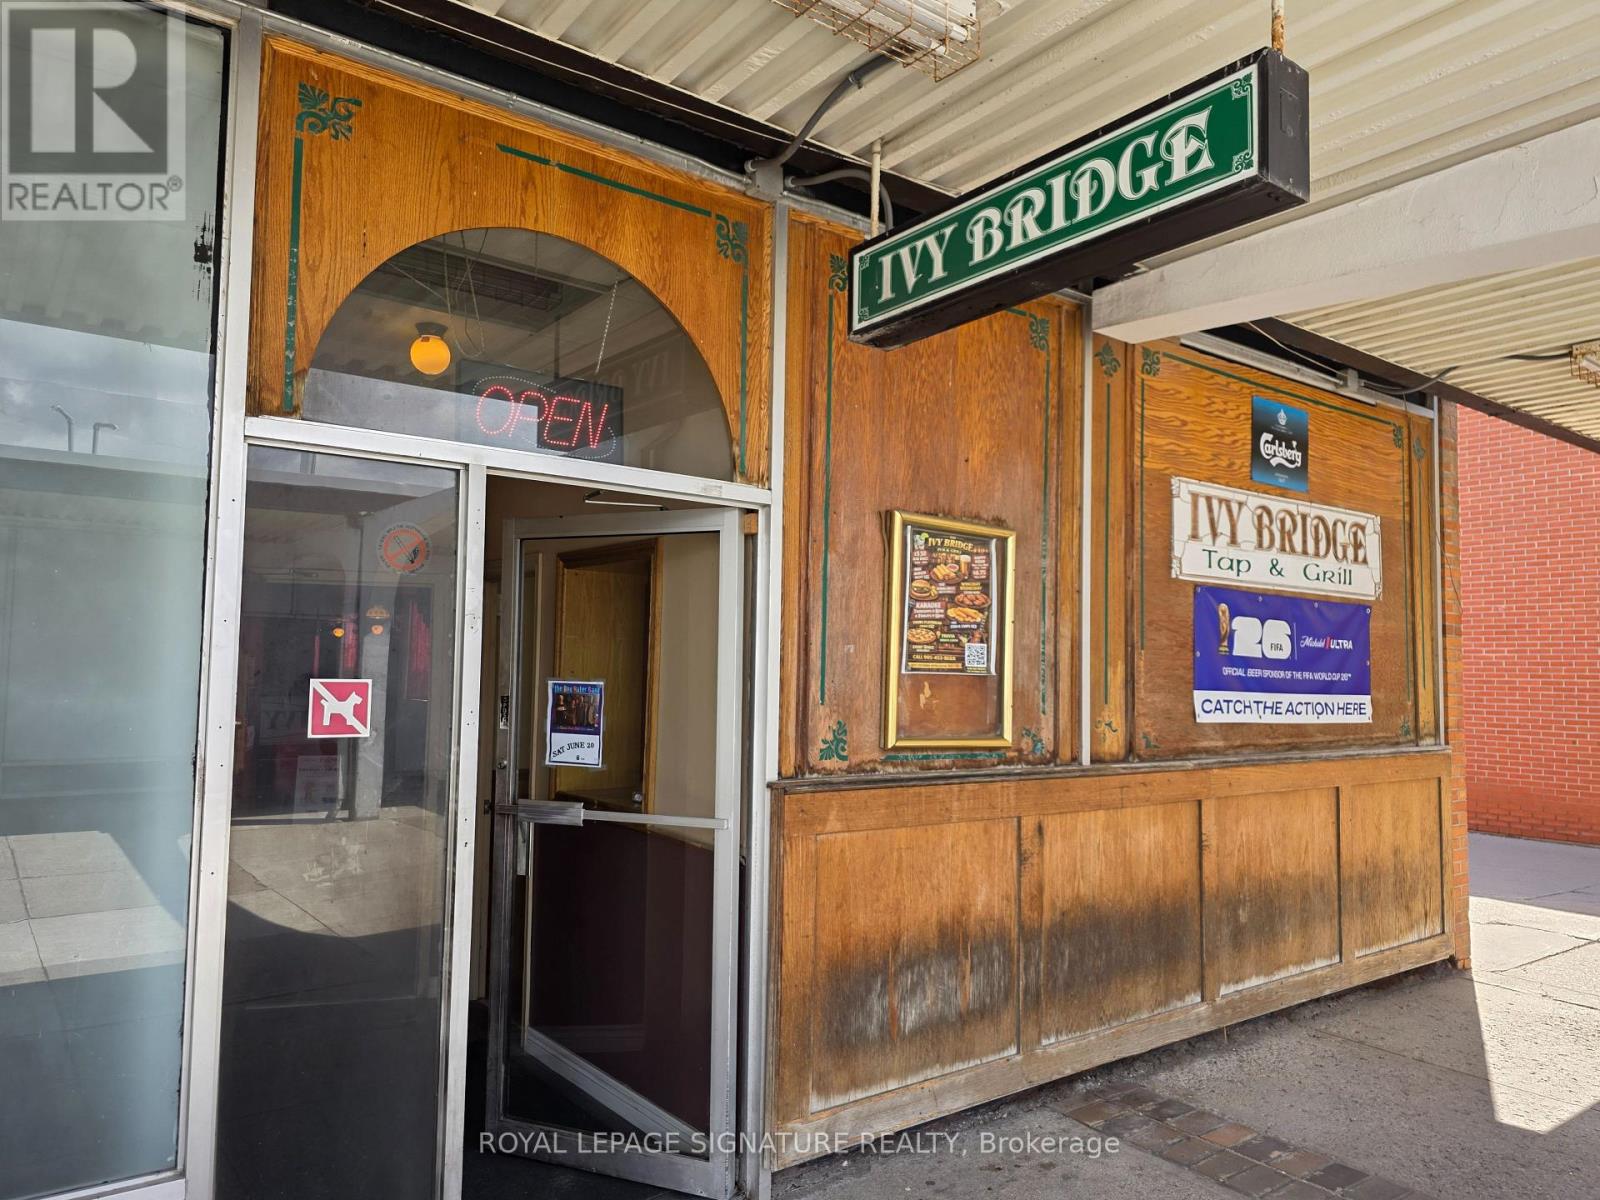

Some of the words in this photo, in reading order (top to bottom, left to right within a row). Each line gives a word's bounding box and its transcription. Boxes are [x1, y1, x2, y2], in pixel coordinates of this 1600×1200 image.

[877, 220, 957, 303] IVY
[966, 106, 1215, 268] BRIDGE
[476, 384, 608, 449] OPEN
[1259, 431, 1302, 468] Carlsberg
[1187, 492, 1245, 546] IVY
[1252, 504, 1369, 565] BRIDGE
[943, 539, 974, 552] BRIDGE
[1201, 548, 1252, 577] Tap
[1269, 557, 1285, 577] &
[1303, 562, 1353, 586] Grill
[1231, 615, 1292, 660] 26
[1270, 642, 1284, 652] FIFA
[1330, 637, 1353, 650] ULTRA
[1222, 666, 1246, 677] OFFICIAL
[1247, 668, 1262, 678] BEER
[1262, 669, 1286, 679] SPONSOR
[1286, 671, 1293, 679] OF
[1293, 671, 1303, 680] THE
[1303, 671, 1313, 680] FIFA
[1313, 672, 1331, 681] WORLD
[1331, 672, 1341, 681] CUP
[1201, 698, 1253, 715] CATCH
[1254, 700, 1283, 717] THE
[1284, 701, 1335, 717] ACTION
[1337, 702, 1367, 717] HERE
[552, 745, 566, 758] SAT
[566, 741, 585, 751] JUNE
